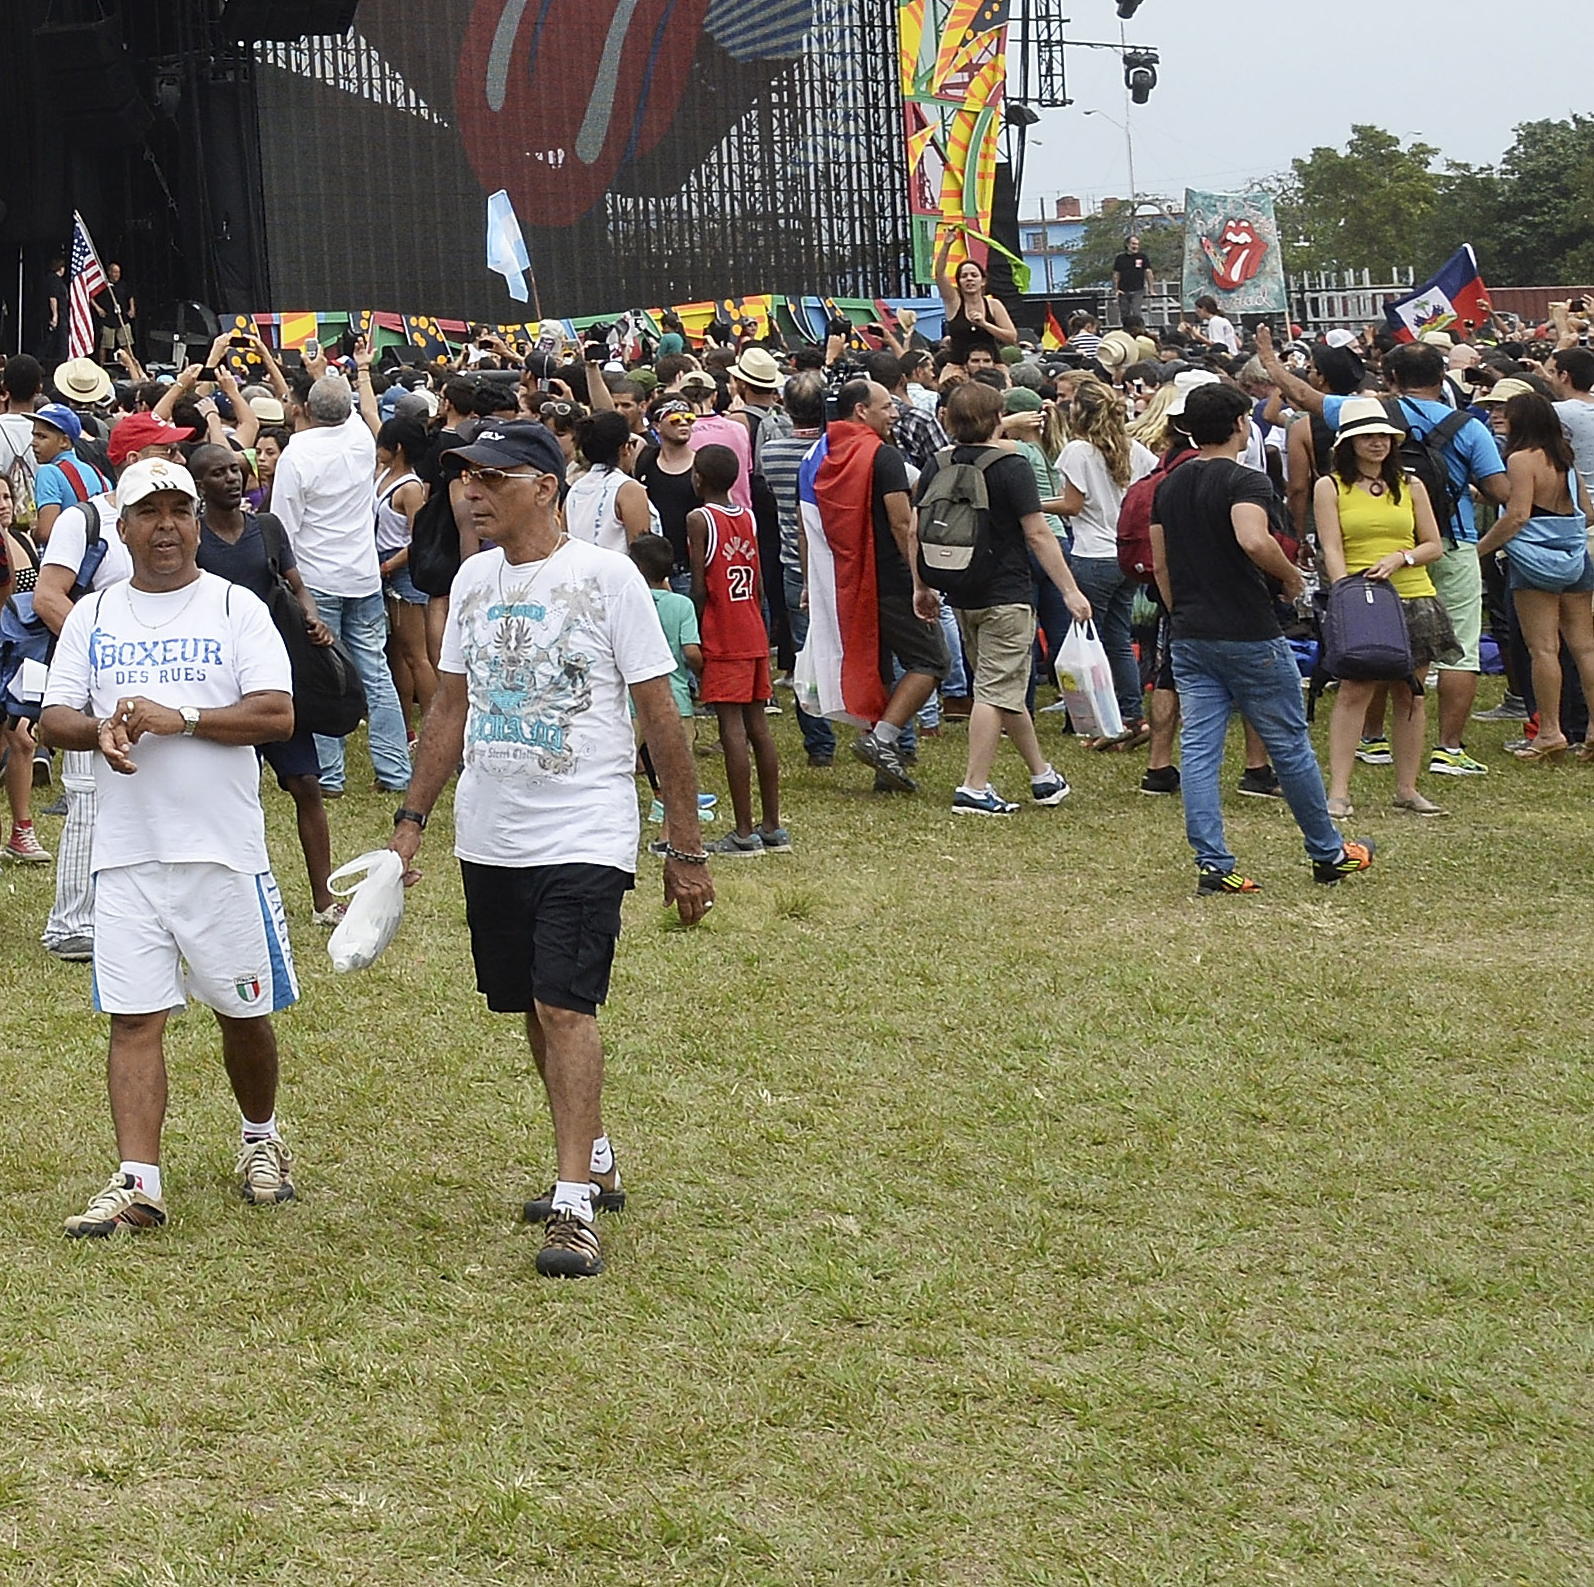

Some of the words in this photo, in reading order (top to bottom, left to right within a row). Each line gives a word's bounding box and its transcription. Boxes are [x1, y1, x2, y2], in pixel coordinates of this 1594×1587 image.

[100, 637, 223, 670] BOXEUR
[116, 669, 148, 684] DES
[159, 667, 206, 683] RUES
